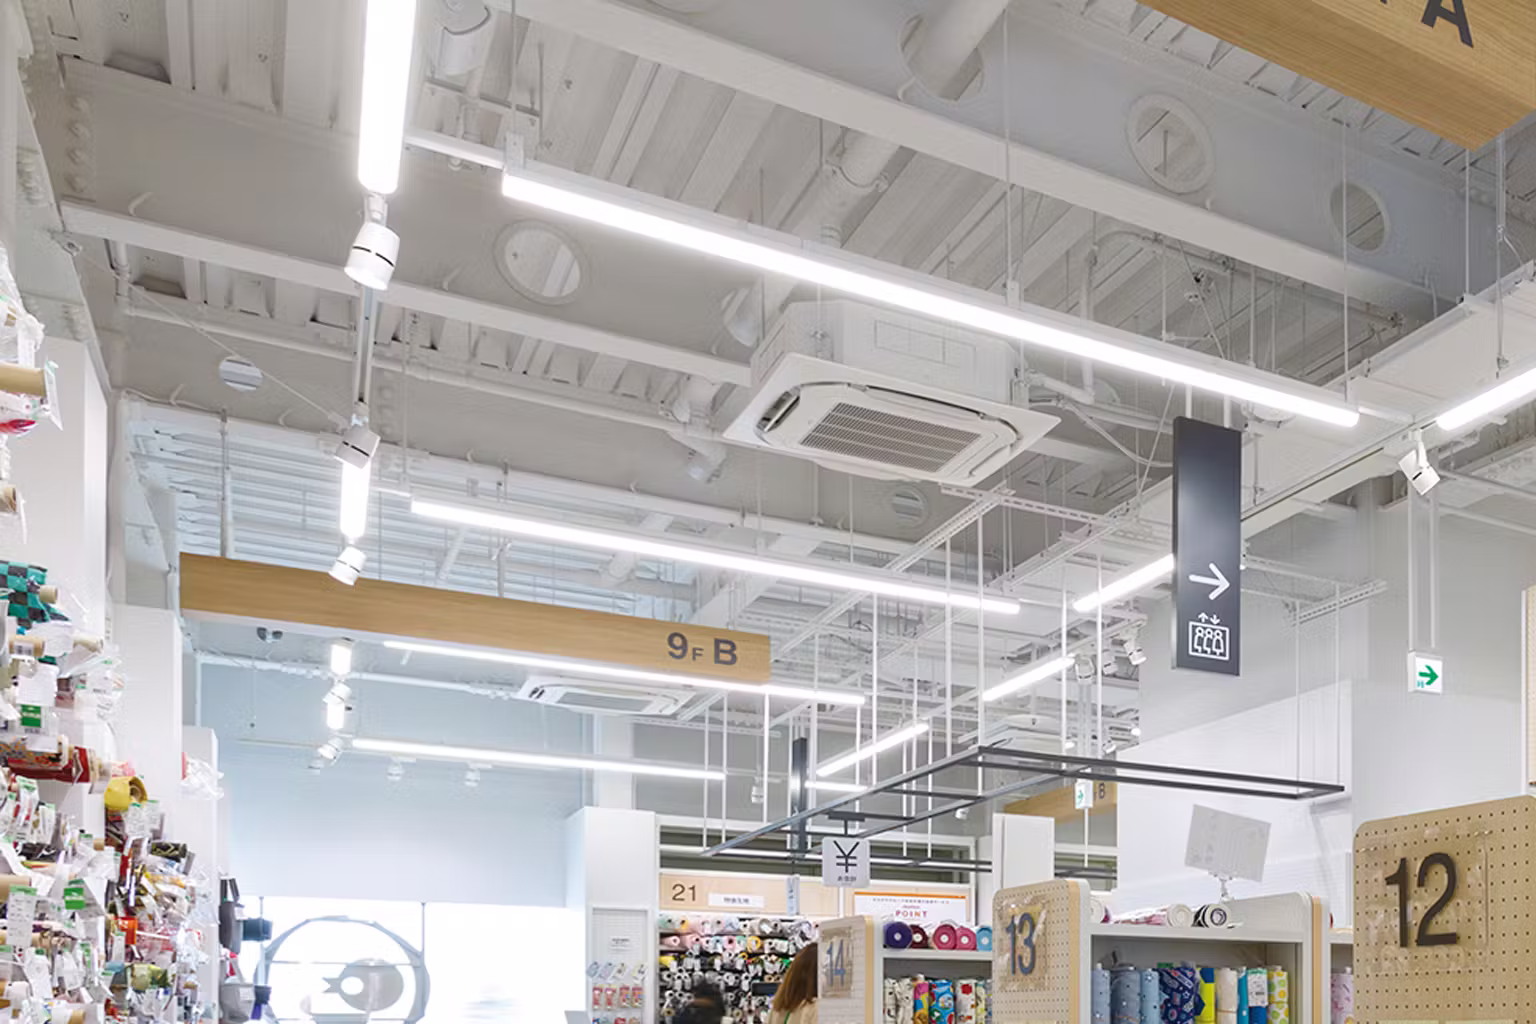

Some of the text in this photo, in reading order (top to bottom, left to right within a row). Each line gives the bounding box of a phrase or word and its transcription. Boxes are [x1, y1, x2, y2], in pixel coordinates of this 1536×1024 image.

[713, 638, 738, 666] B
[671, 883, 696, 902] 21
[1384, 852, 1458, 948] 12
[895, 910, 928, 918] POINT
[826, 939, 847, 987] 14
[1005, 912, 1036, 976] 13
